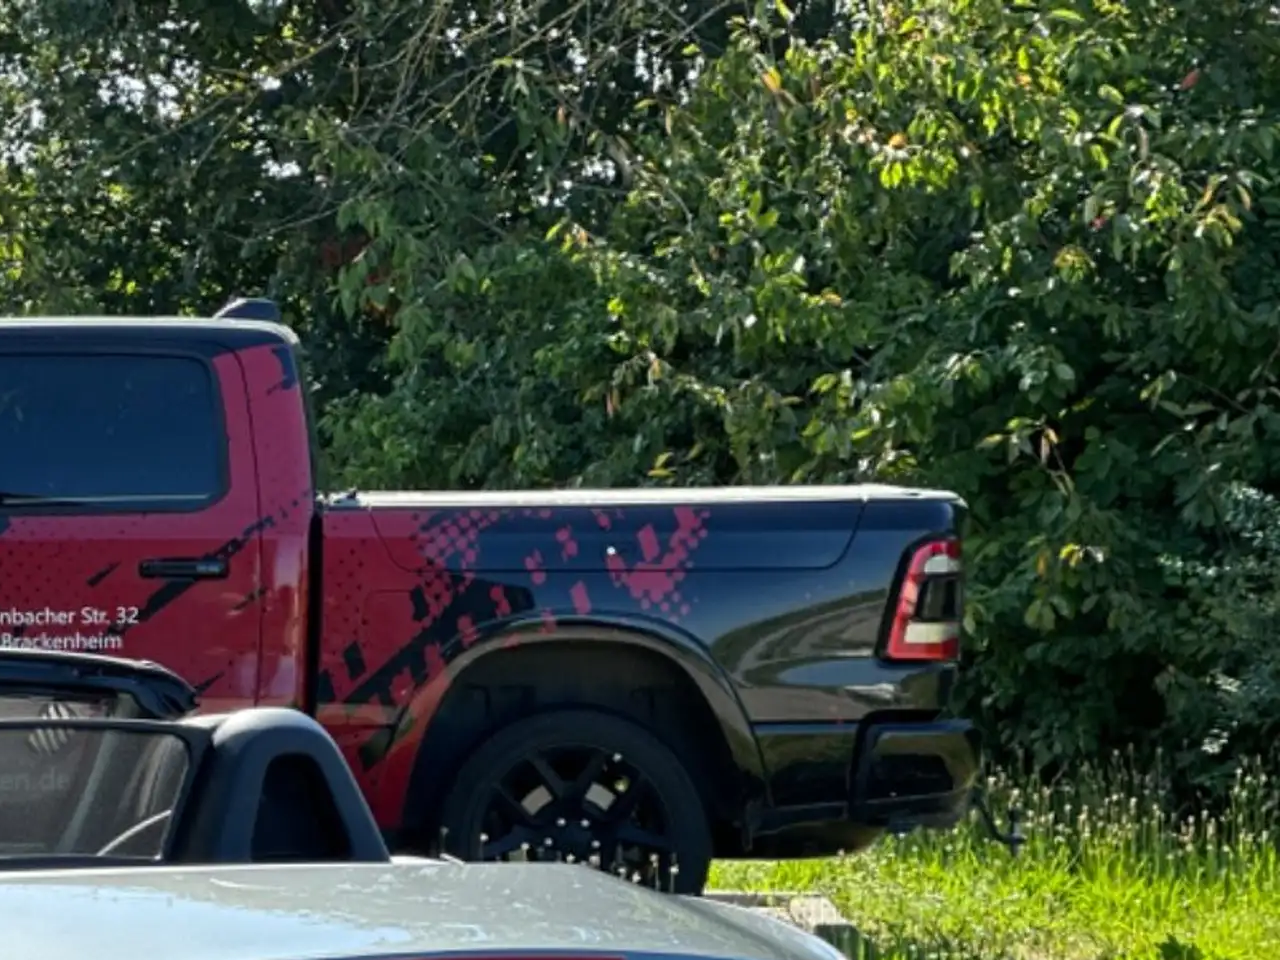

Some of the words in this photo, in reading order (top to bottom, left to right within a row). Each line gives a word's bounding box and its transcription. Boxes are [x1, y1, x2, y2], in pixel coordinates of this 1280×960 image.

[81, 607, 111, 625] Str.
[116, 606, 139, 625] 32
[0, 631, 123, 650] Brackenheim
